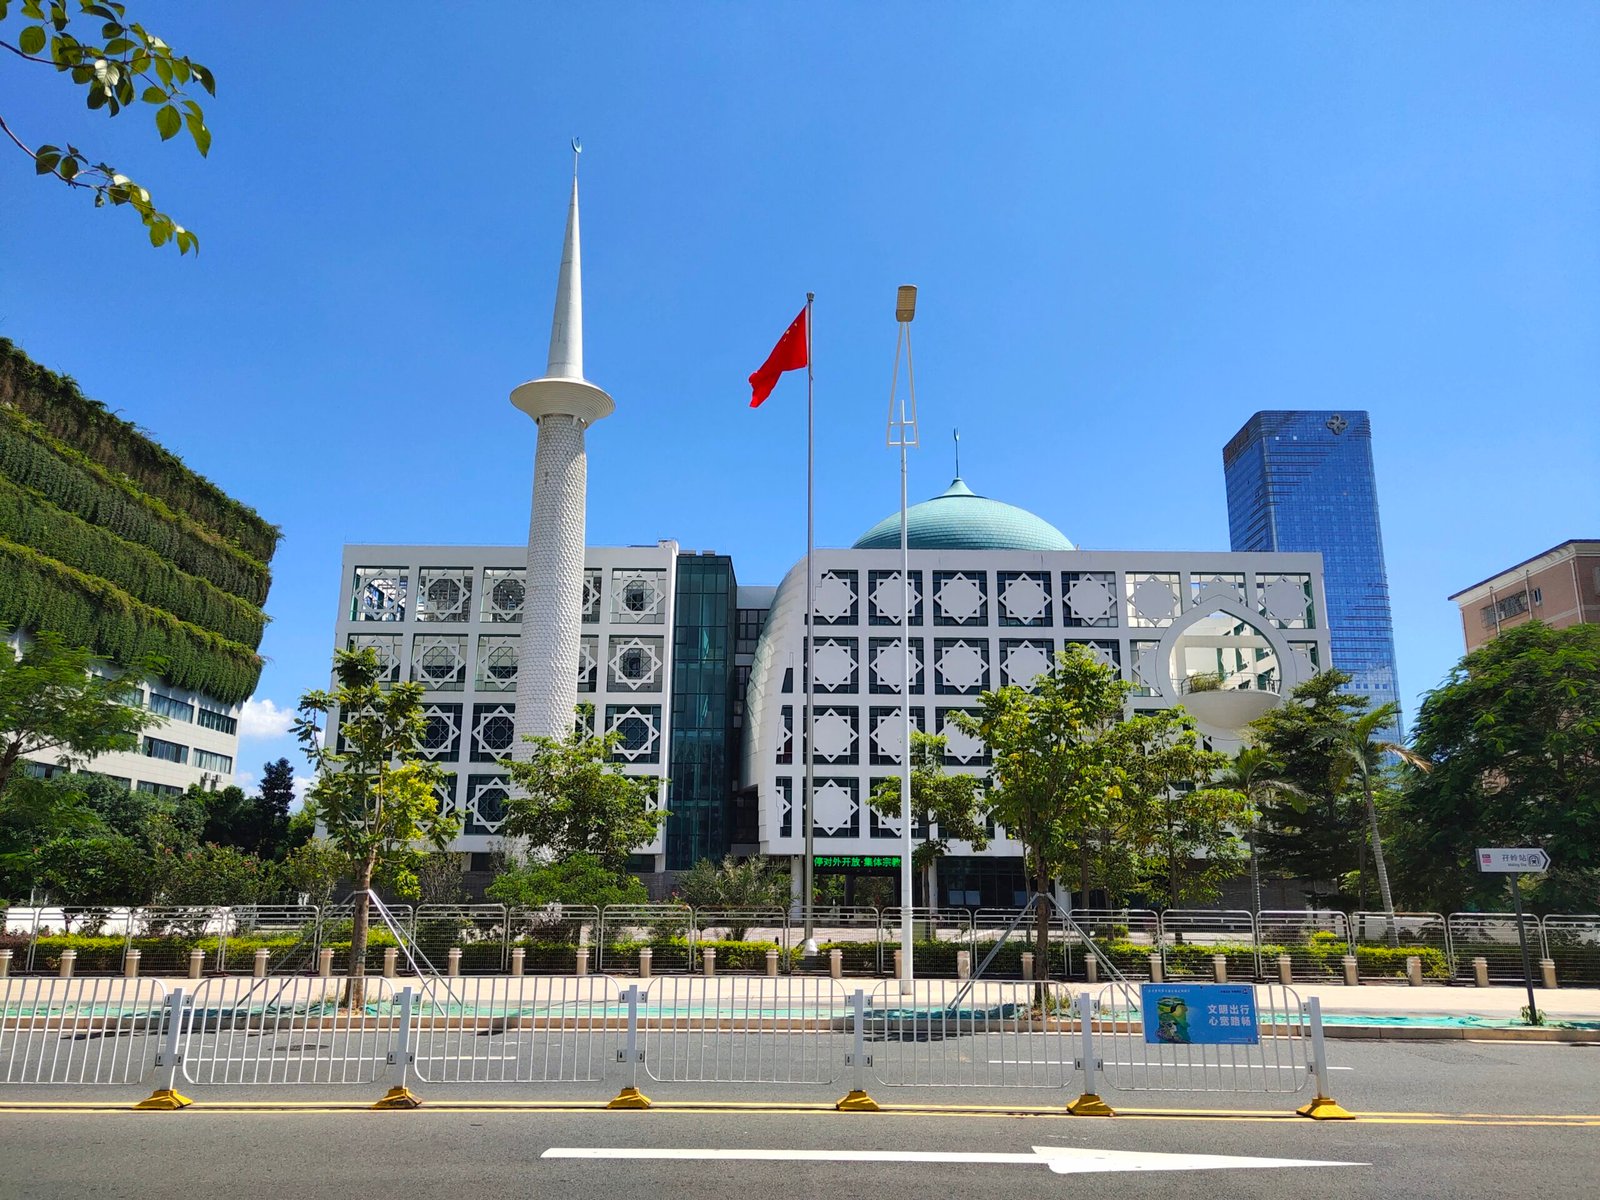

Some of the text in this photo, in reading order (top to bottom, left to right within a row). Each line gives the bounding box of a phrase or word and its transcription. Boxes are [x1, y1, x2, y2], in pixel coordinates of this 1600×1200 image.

[1208, 1004, 1249, 1014] 文明出行
[1209, 1016, 1251, 1026] 心宽路畅
